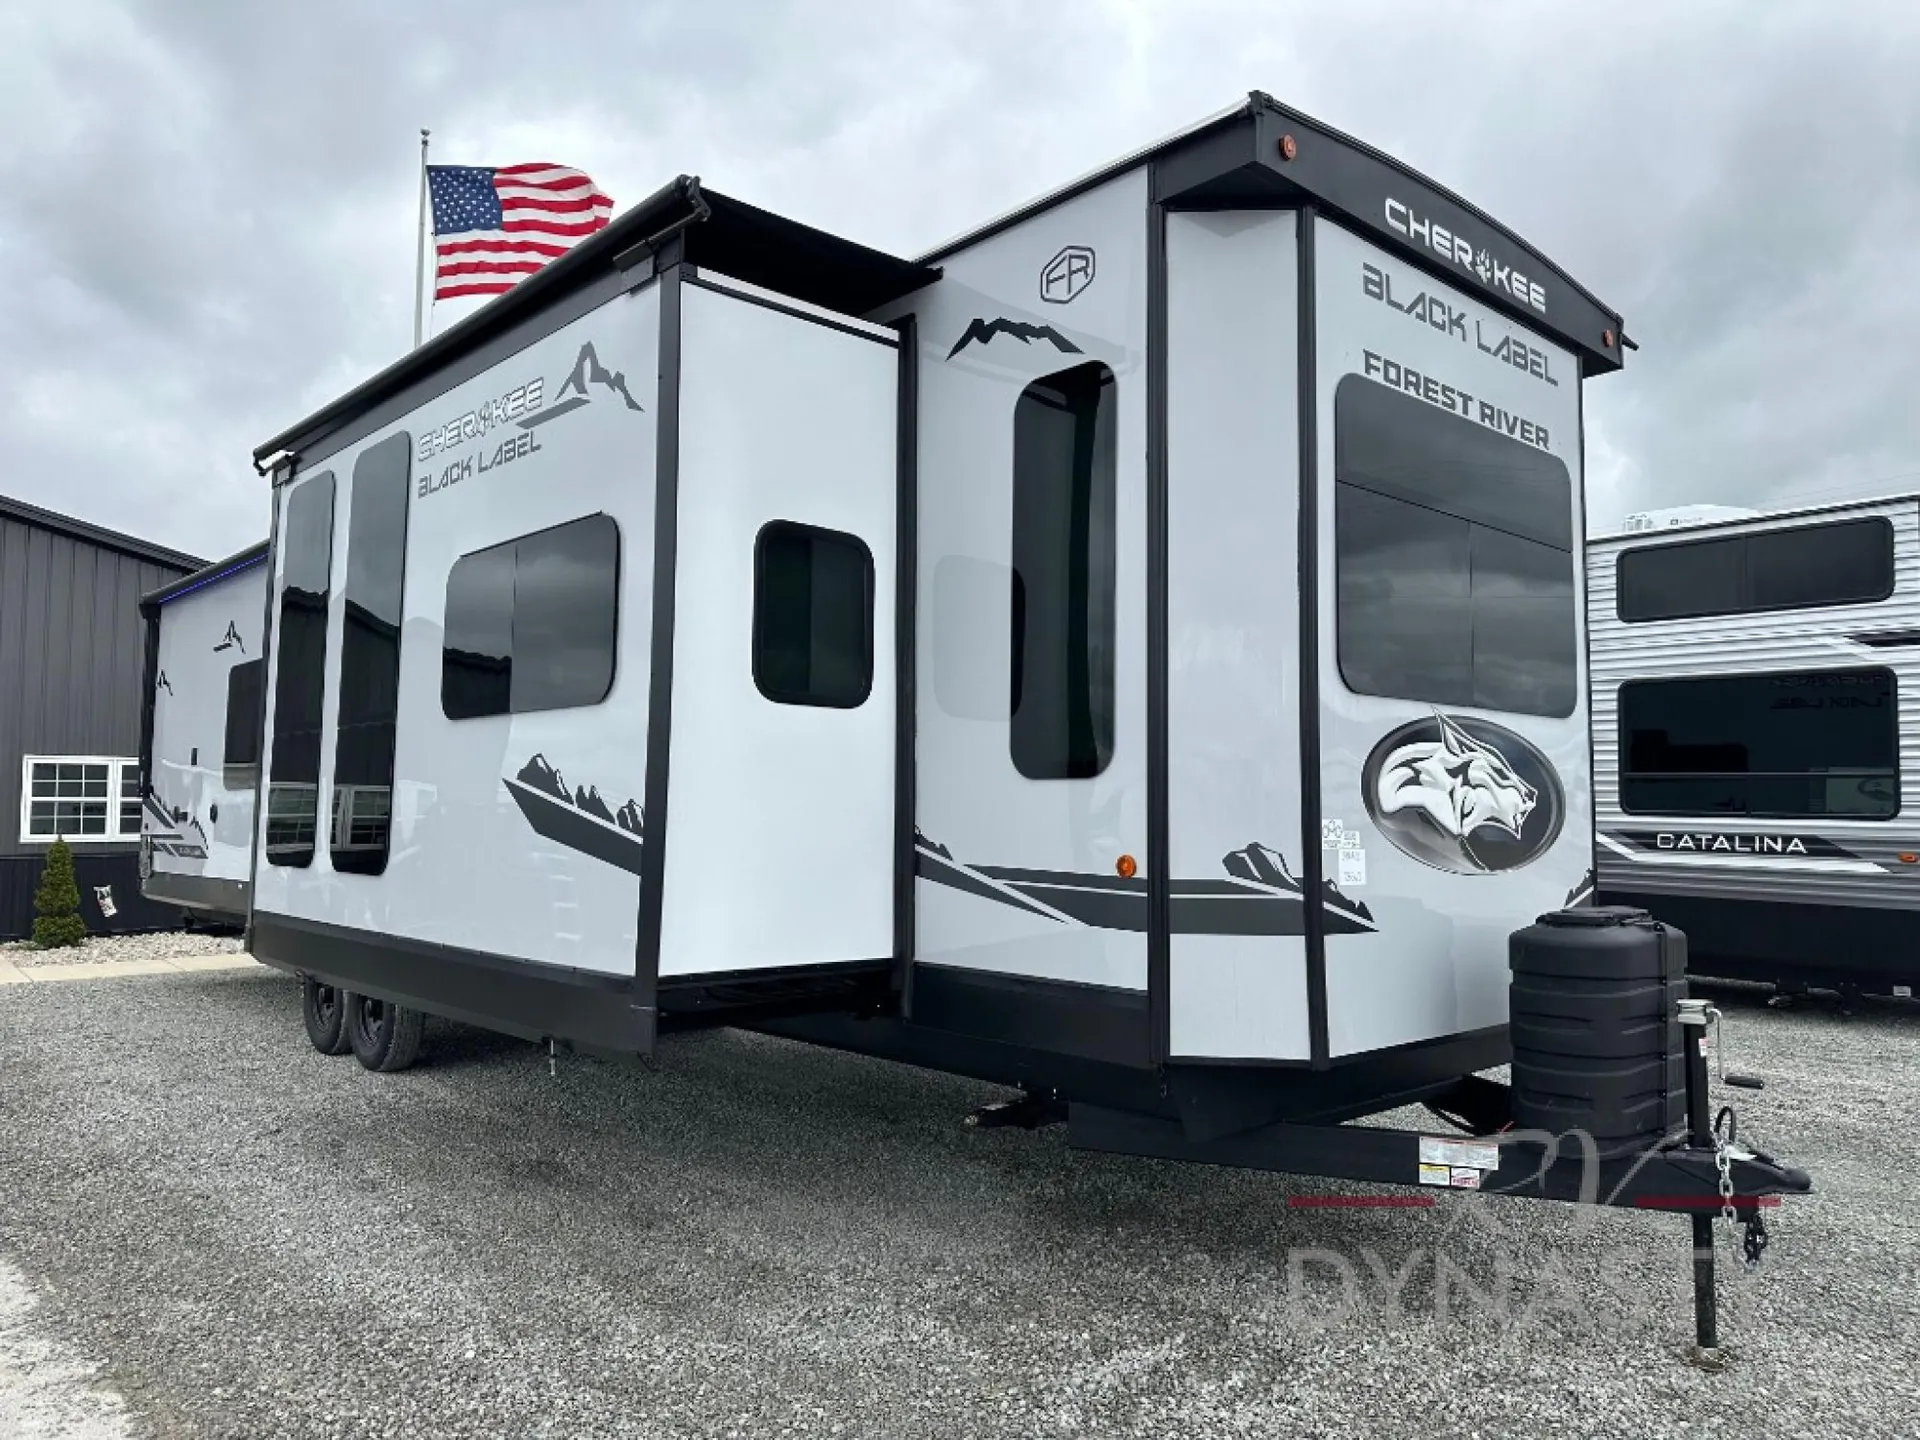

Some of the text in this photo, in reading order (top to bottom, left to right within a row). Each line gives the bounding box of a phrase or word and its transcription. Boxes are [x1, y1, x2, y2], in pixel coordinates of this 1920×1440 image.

[1362, 261, 1559, 386] BLACK LABEL
[1363, 348, 1550, 450] FOREST RIVER
[418, 430, 542, 499] BLACK LABEL
[1656, 833, 1808, 854] CATALINA
